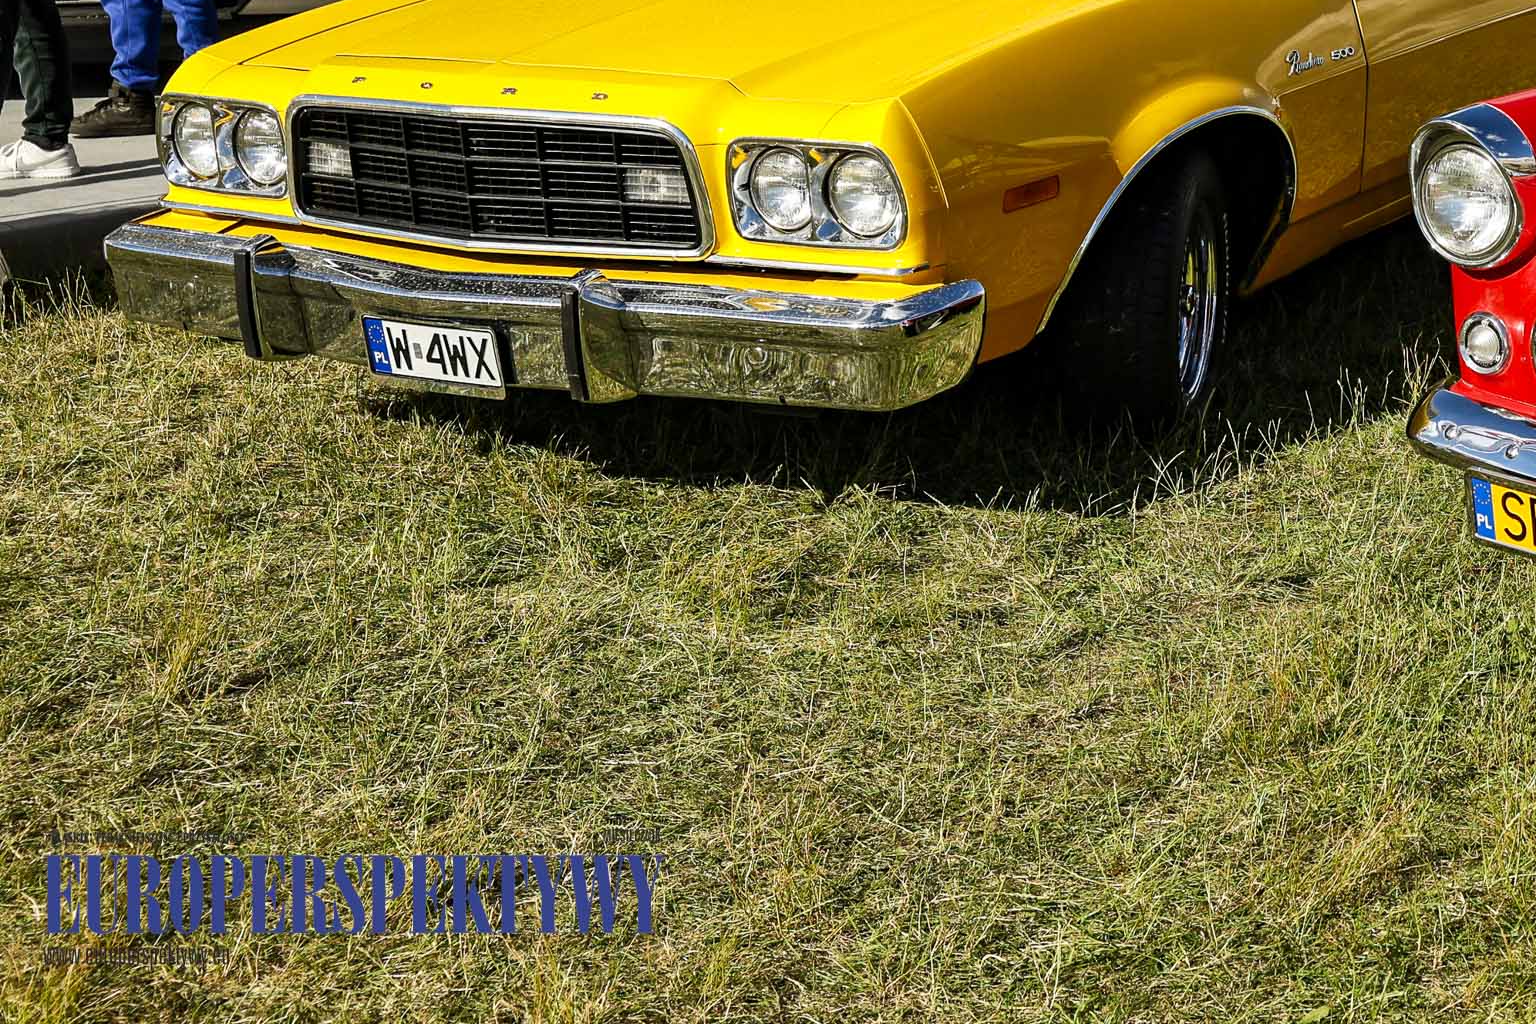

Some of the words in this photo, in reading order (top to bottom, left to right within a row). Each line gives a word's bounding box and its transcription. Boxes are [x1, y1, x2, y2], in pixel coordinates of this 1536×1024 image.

[1331, 46, 1355, 60] 500
[374, 352, 389, 364] PL
[386, 327, 413, 371] W
[426, 333, 496, 380] 4WX
[1476, 513, 1493, 530] PL
